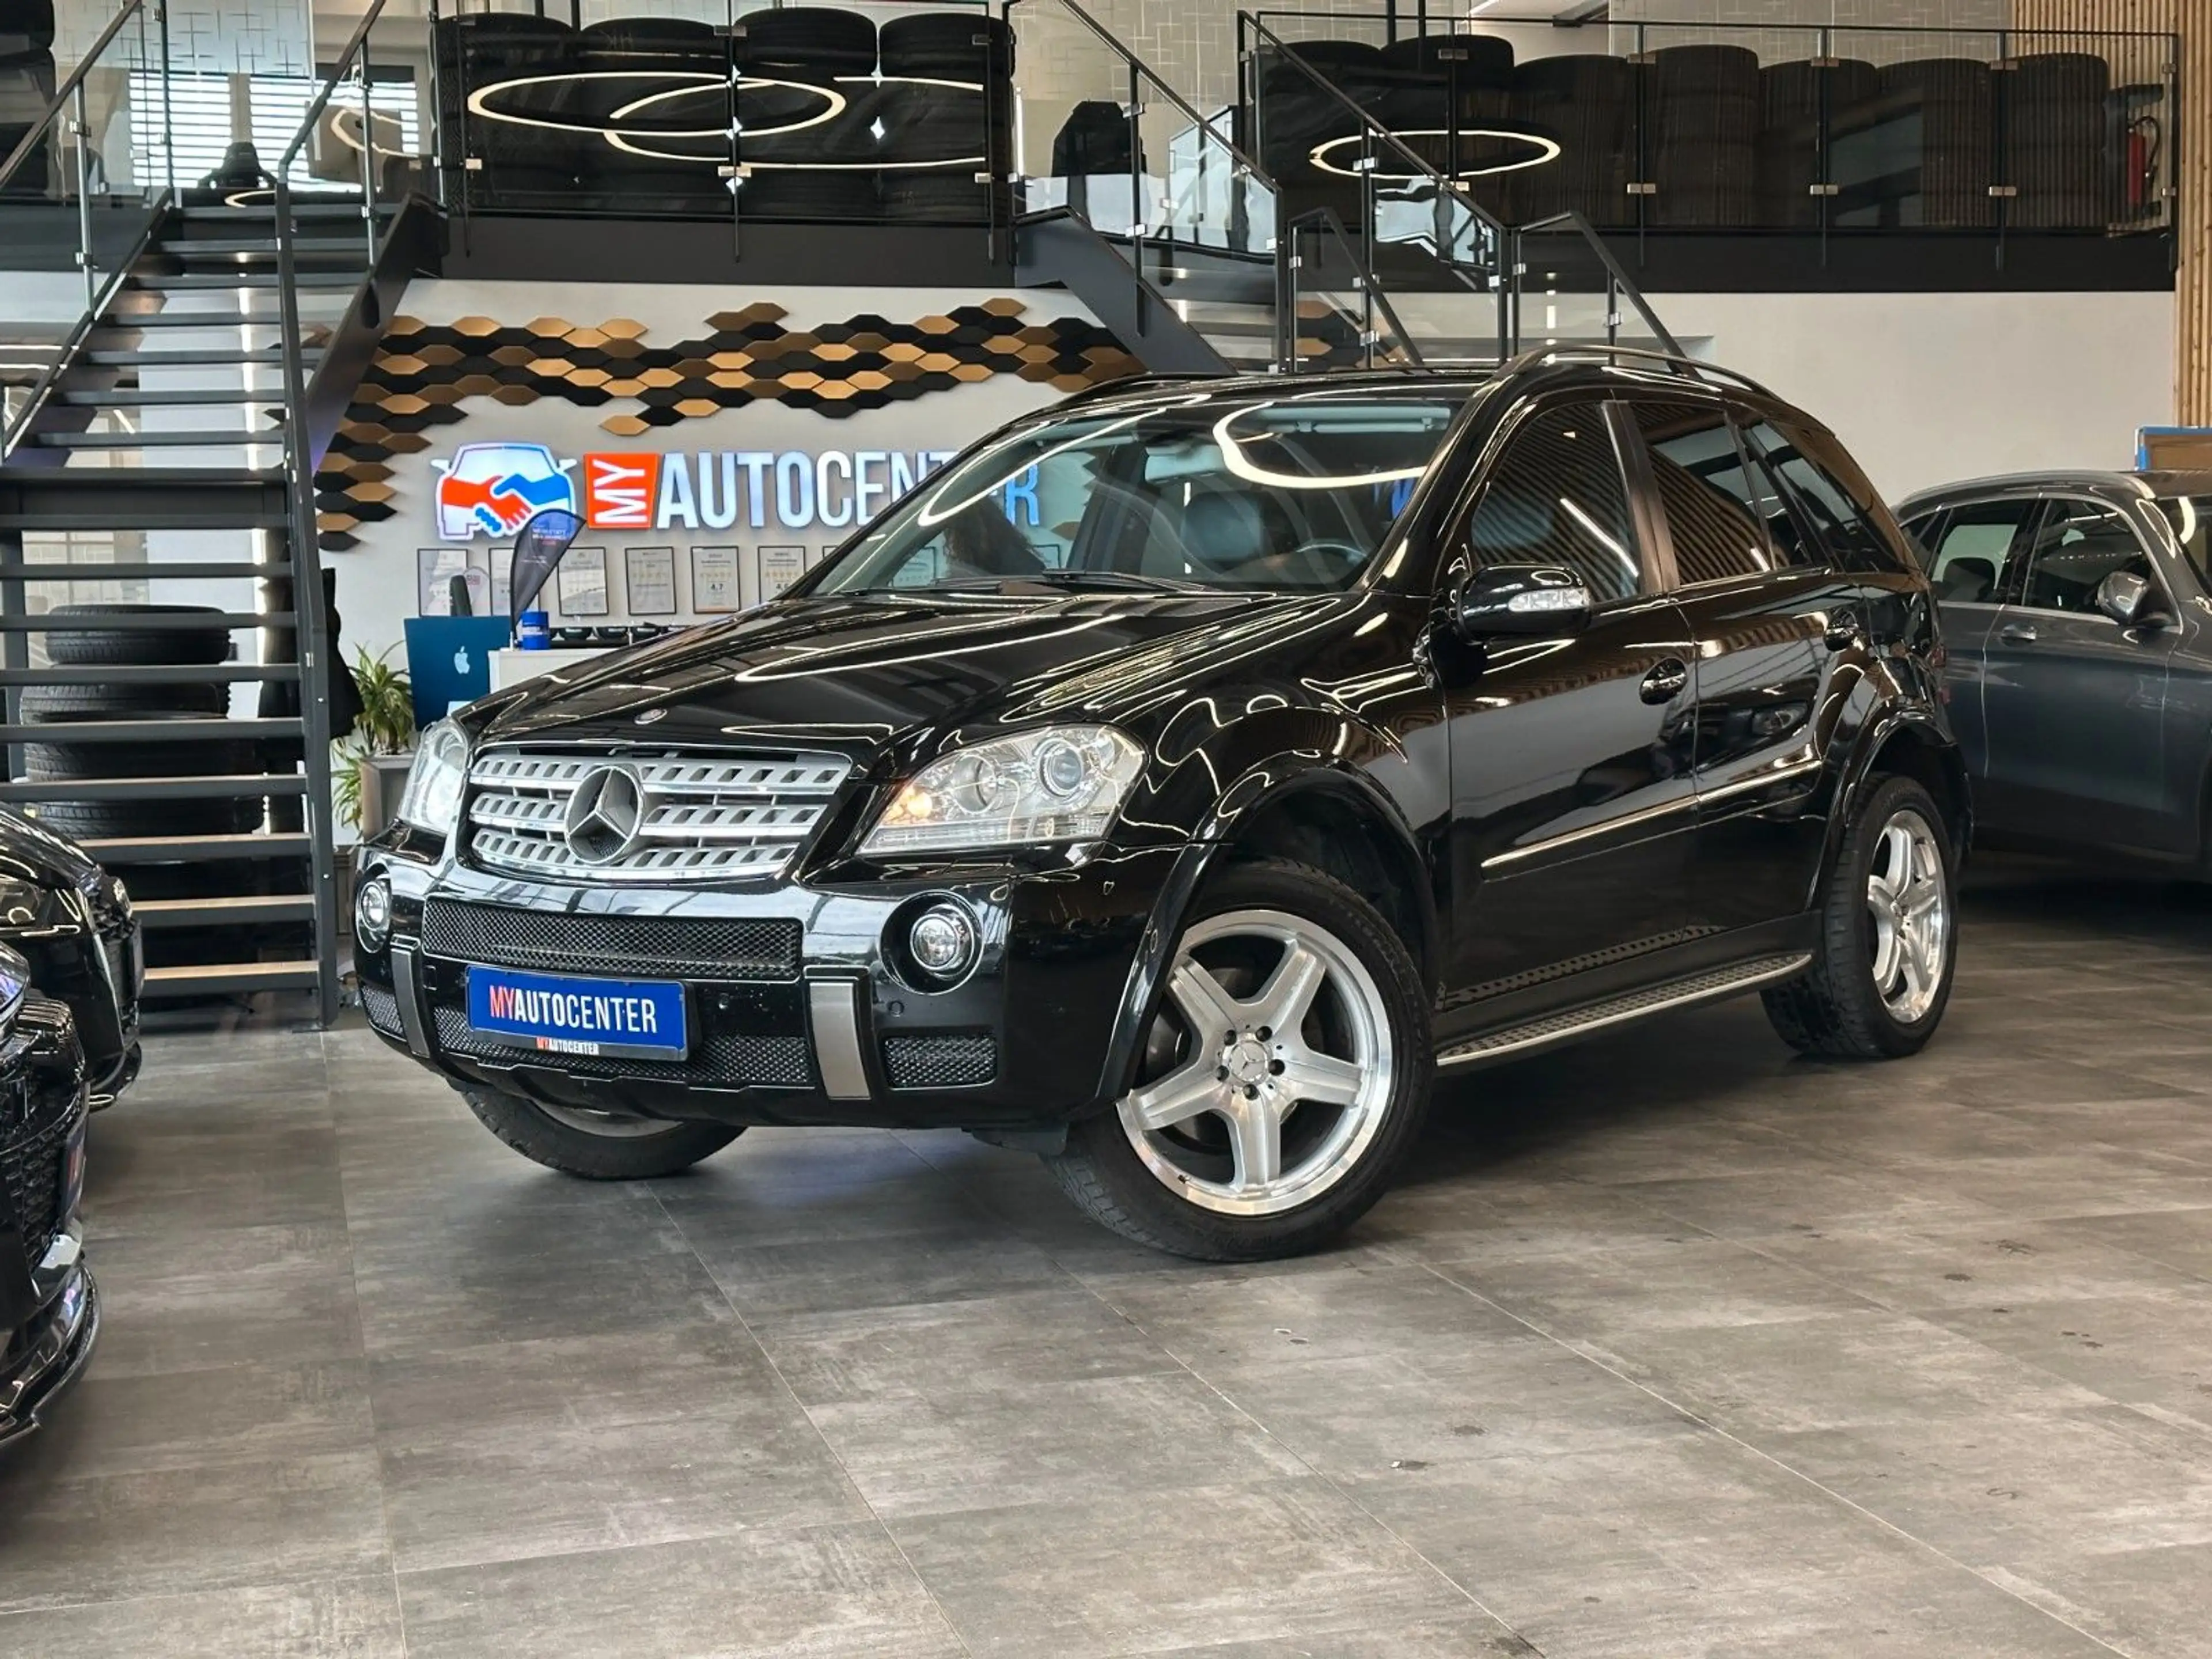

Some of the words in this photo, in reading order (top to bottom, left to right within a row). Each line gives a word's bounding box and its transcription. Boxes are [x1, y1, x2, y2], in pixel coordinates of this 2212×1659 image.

[592, 459, 647, 524] MY
[657, 450, 1039, 529] AUTOCENR
[489, 985, 657, 1033] MYAUTOCENTER
[536, 1036, 599, 1055] MYAUTOCENTER
